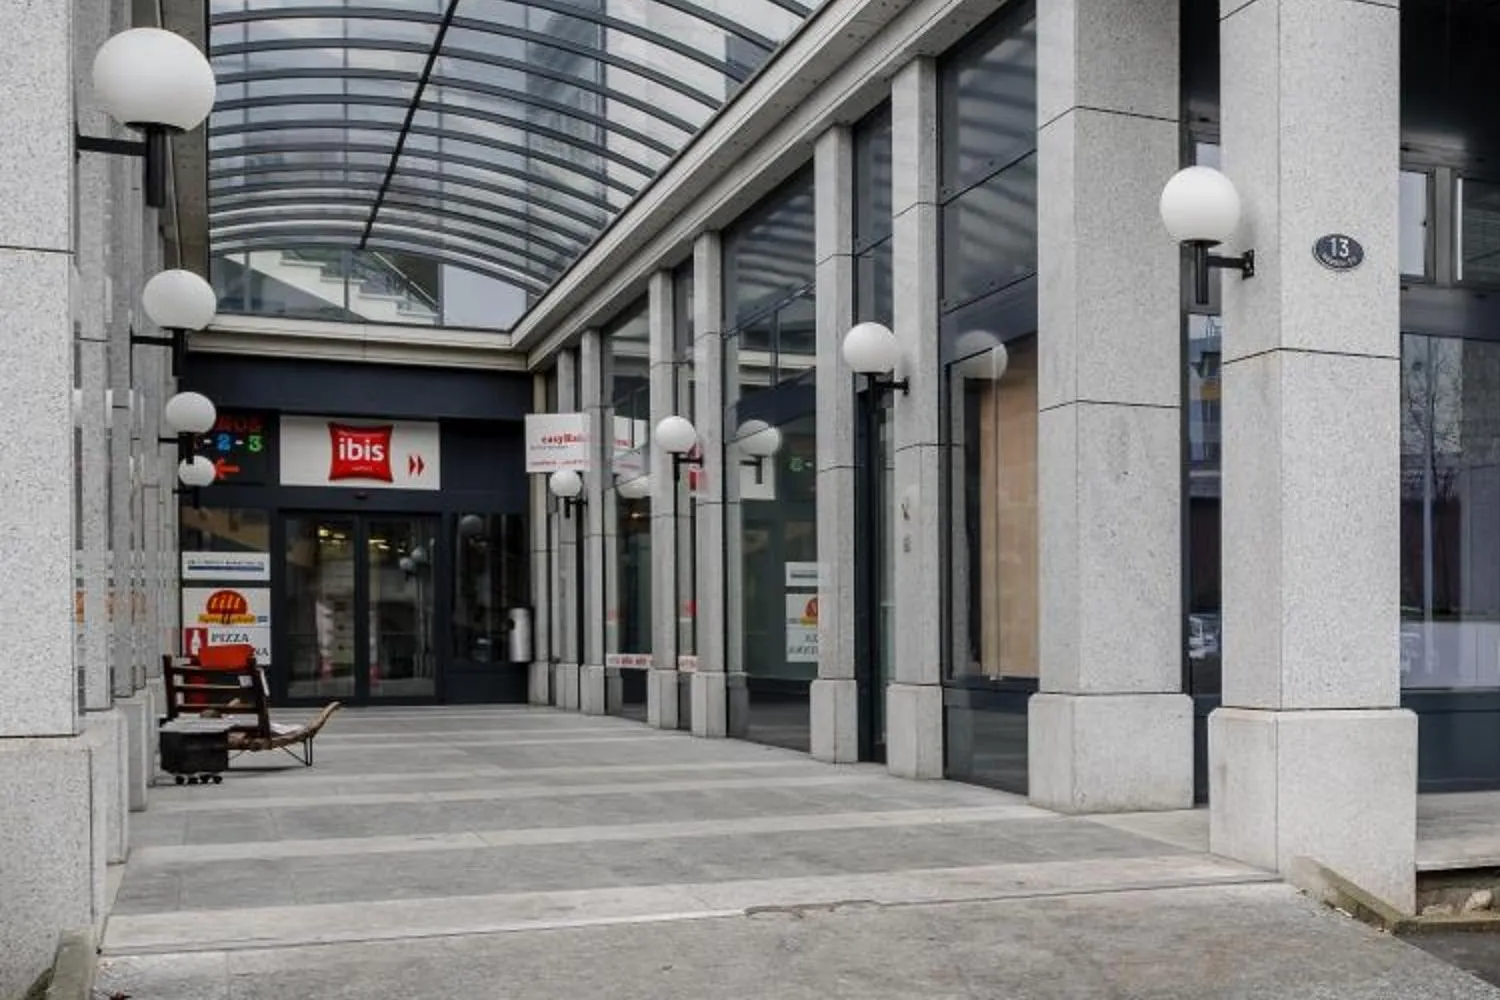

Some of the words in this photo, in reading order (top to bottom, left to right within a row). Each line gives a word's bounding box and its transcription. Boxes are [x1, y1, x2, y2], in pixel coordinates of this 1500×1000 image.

[1330, 237, 1349, 257] 13
[339, 438, 385, 461] ibis
[211, 633, 249, 642] PIZZA
